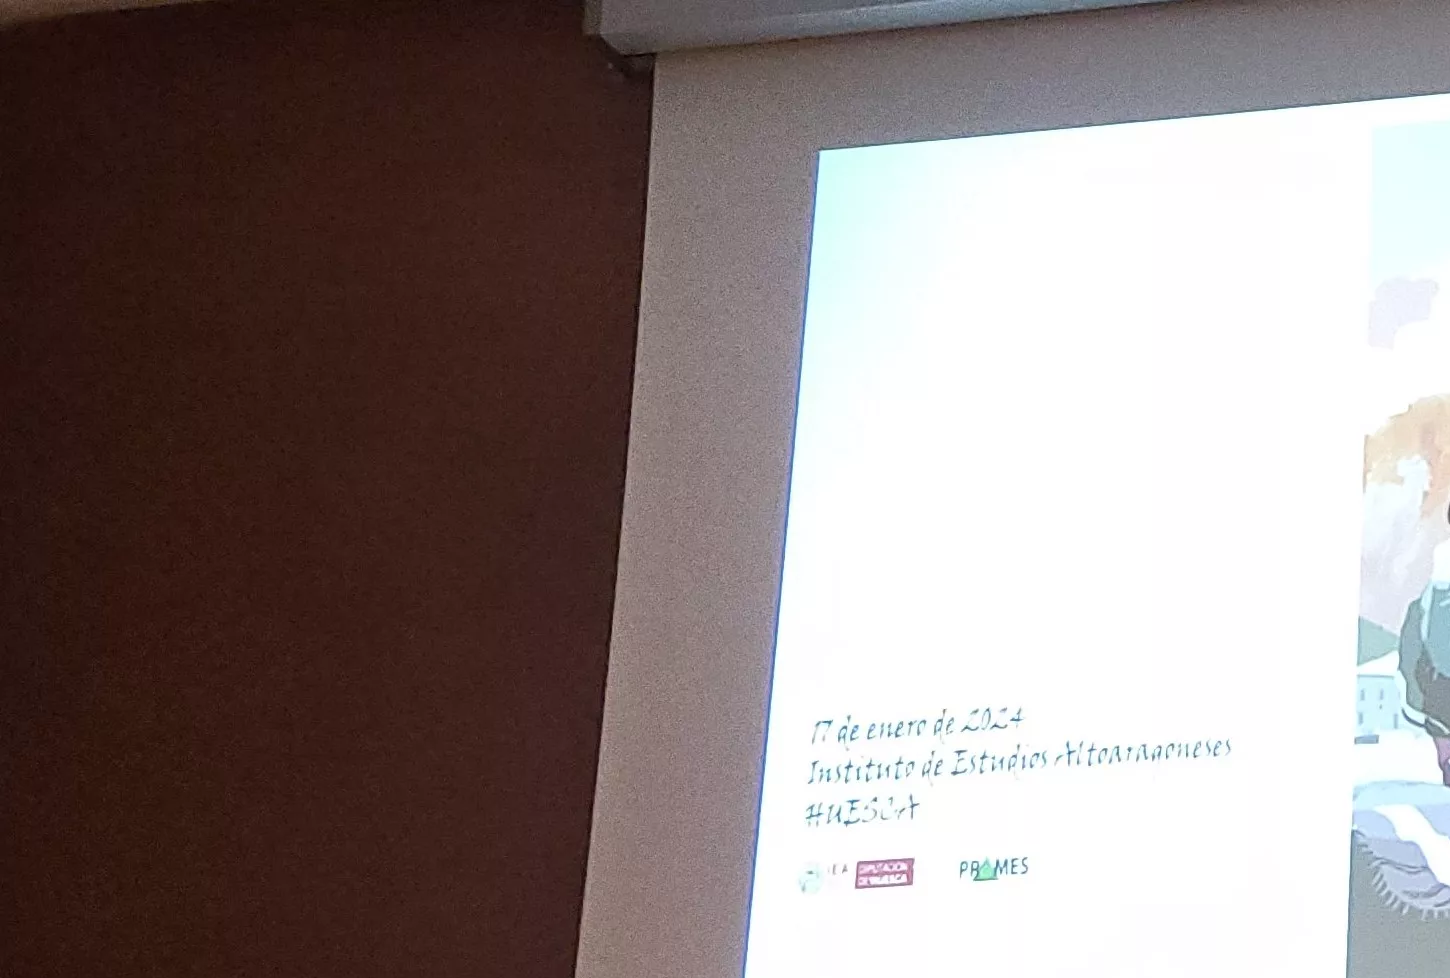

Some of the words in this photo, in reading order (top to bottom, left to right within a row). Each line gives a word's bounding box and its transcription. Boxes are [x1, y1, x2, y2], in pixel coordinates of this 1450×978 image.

[837, 714, 860, 751] de
[866, 718, 927, 741] enero
[933, 708, 955, 745] de
[961, 706, 1024, 732] 2024
[807, 755, 916, 785] Instituto
[921, 750, 944, 787] de
[950, 743, 1048, 780] Estudios
[1053, 737, 1232, 768] Altoaragoneses
